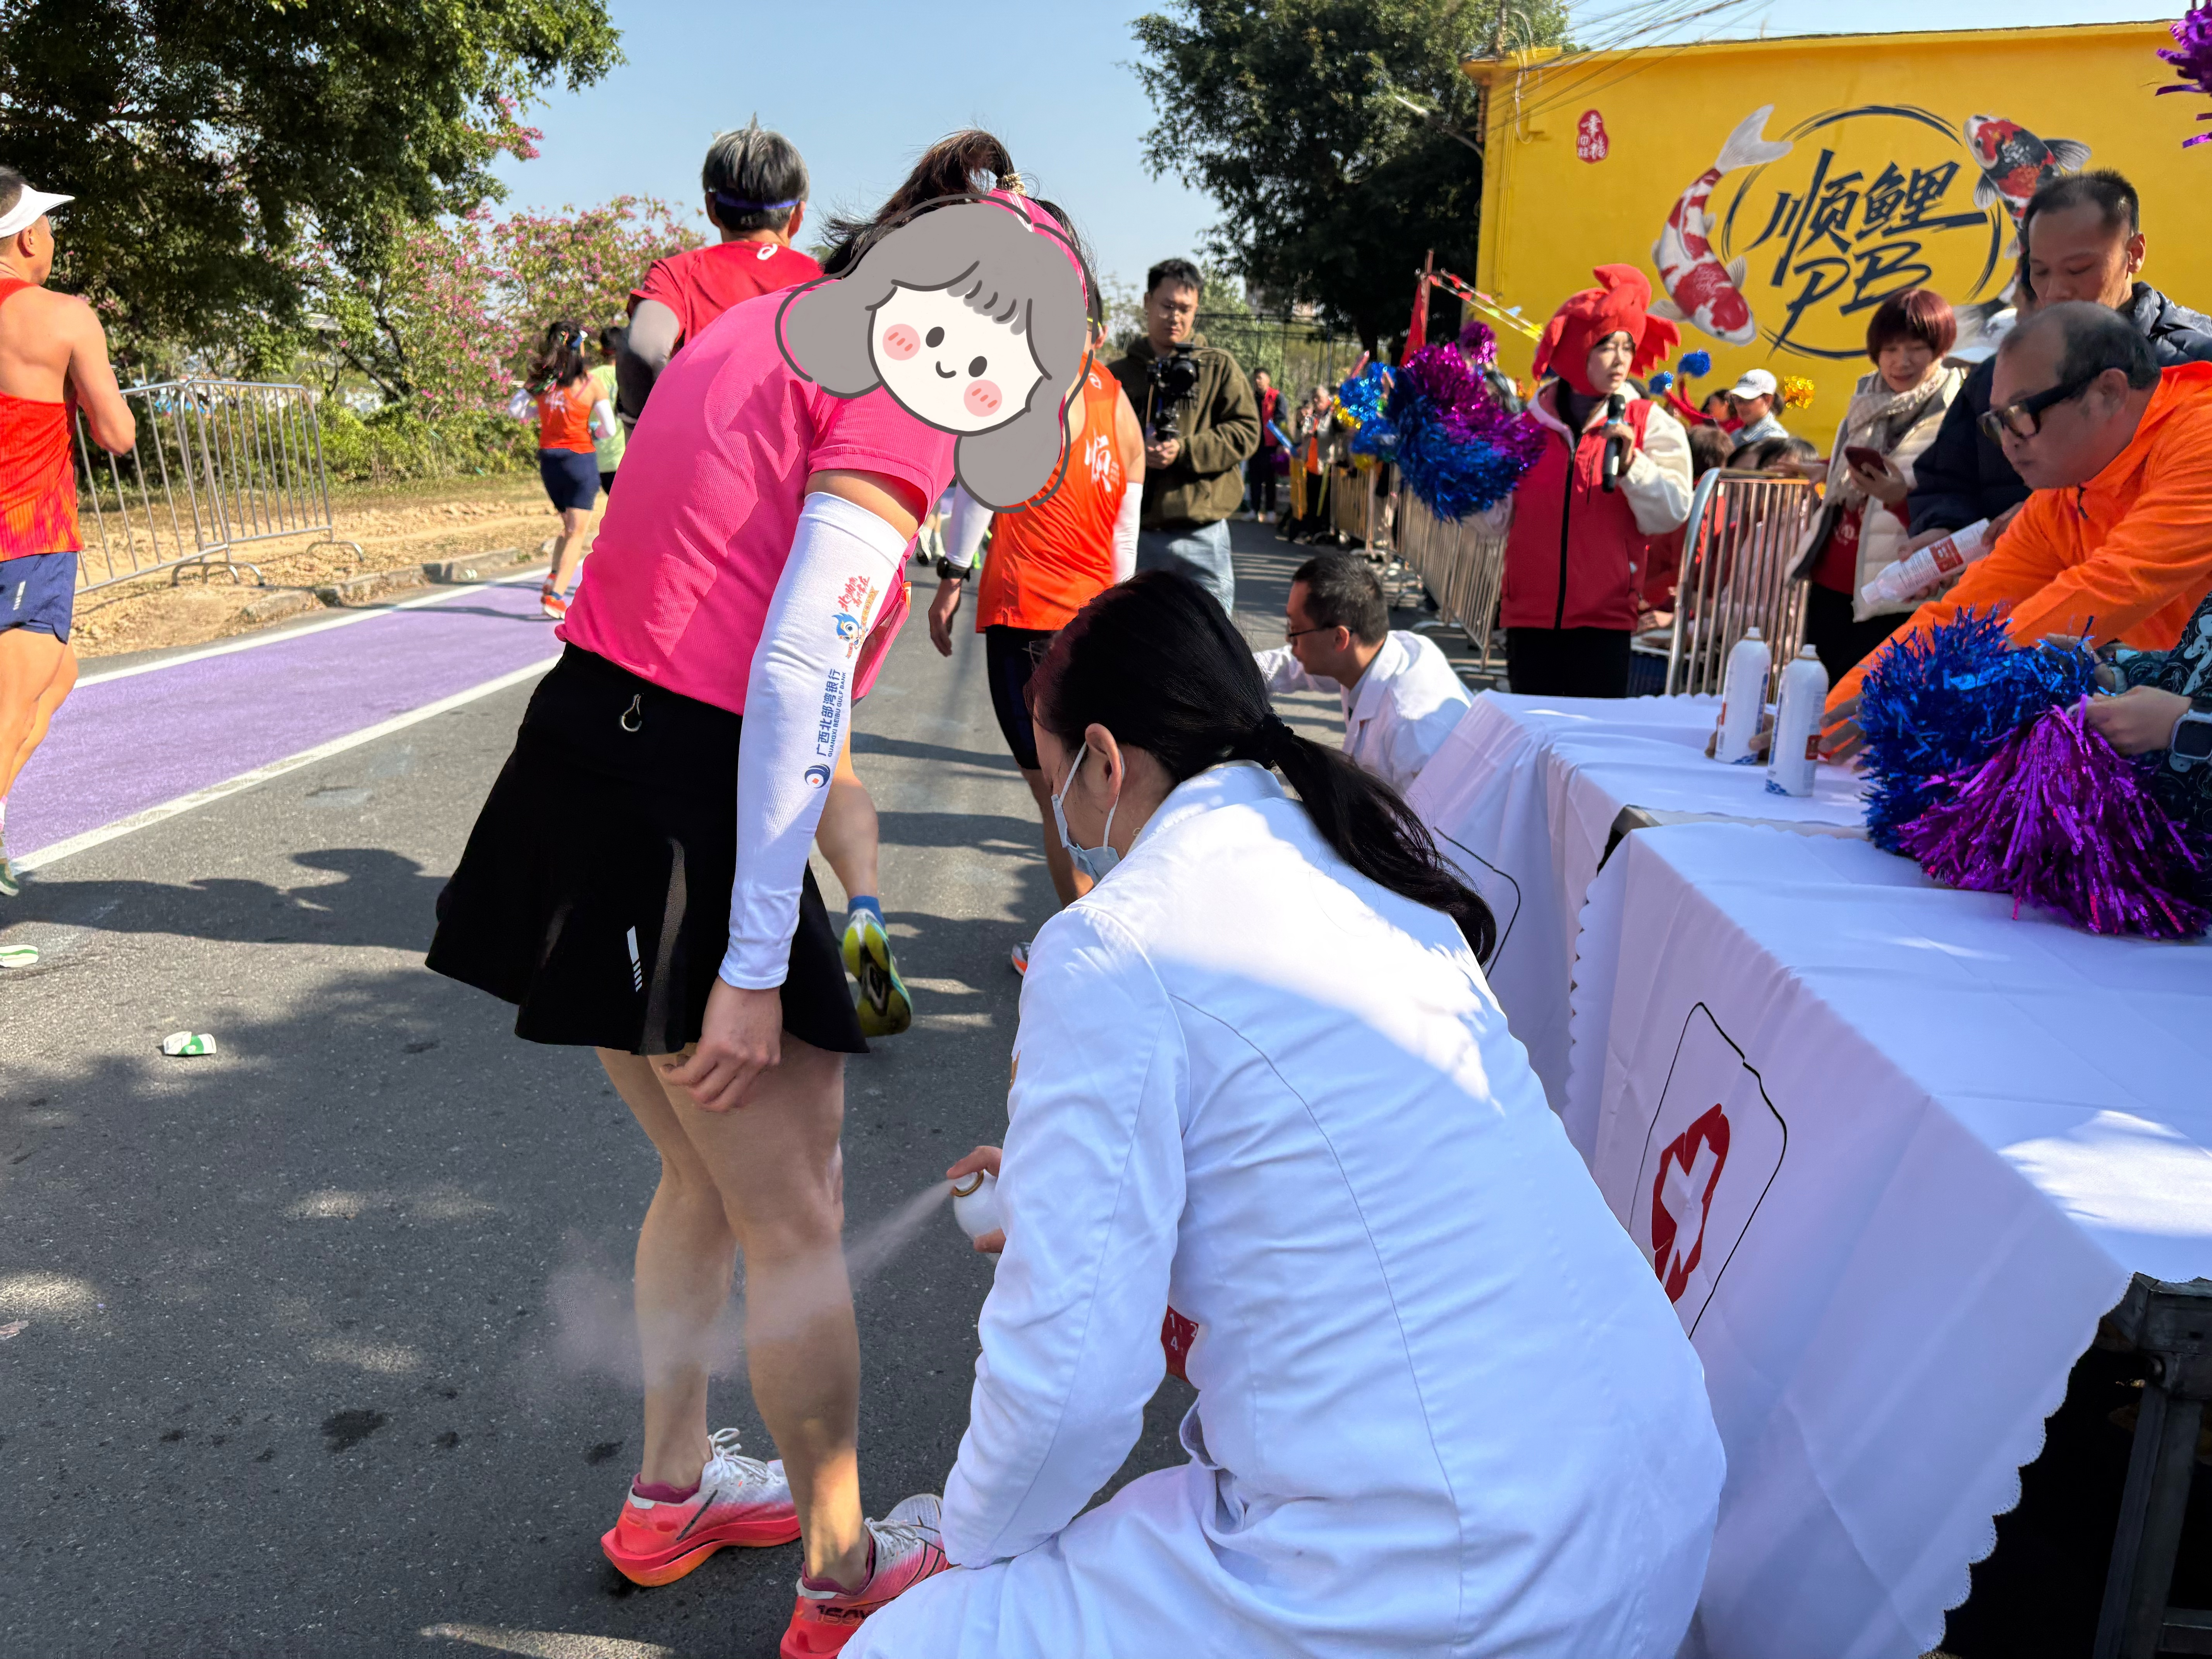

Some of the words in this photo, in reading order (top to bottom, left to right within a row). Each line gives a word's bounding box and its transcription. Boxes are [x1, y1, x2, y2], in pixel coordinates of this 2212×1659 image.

[1743, 148, 1988, 287] 顺鲤
[1767, 241, 1932, 358] PB
[817, 668, 841, 756] 广西北部湾银行
[828, 729, 838, 757] GUANGXI
[833, 709, 841, 727] BEIBU
